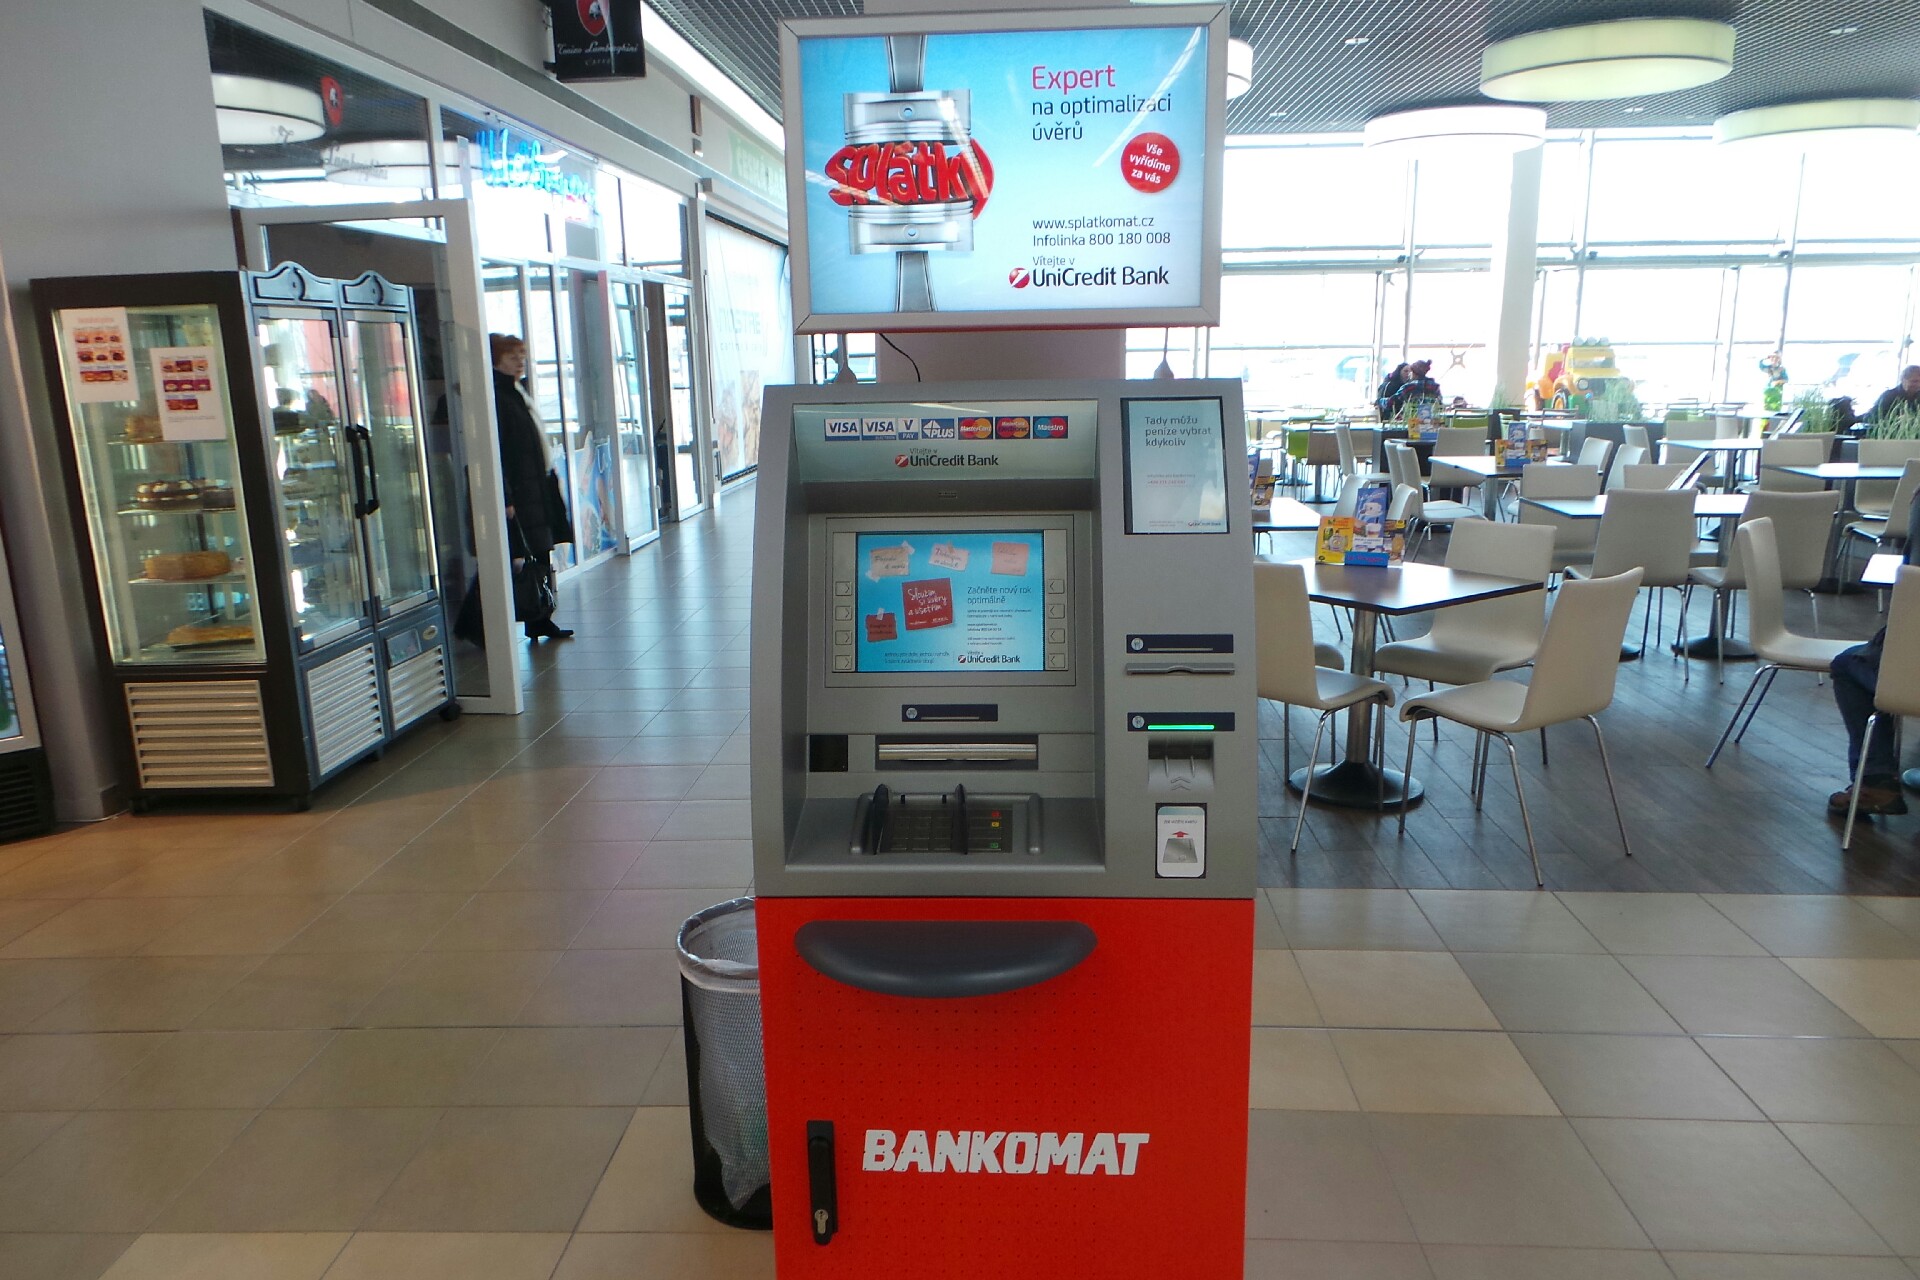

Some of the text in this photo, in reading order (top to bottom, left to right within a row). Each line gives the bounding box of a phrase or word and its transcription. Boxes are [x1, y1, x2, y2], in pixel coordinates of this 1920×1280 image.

[1032, 64, 1116, 95] Expert
[1032, 93, 1171, 119] na optimalizaci
[1032, 120, 1083, 141] úvěrů
[1146, 142, 1163, 156] Vše
[1129, 154, 1171, 173] vyřídíme
[1131, 168, 1161, 184] za vás
[1033, 215, 1154, 231] www.splatkomat.cz
[1033, 232, 1171, 247] Infolinka 800 180 008
[1033, 255, 1075, 268] Vítejte v
[1033, 265, 1170, 287] UniCredit Bank
[828, 422, 858, 433] VISA
[866, 421, 895, 432] VISA
[904, 419, 914, 430] V
[1145, 416, 1198, 426] Tady můžu
[930, 428, 954, 438] PLUS
[1145, 426, 1212, 437] peníze vybrat
[1145, 438, 1186, 448] kdykoliv
[910, 454, 999, 467] UniCredit Bank
[967, 585, 1032, 596] Začněte nový rok
[967, 595, 1006, 605] optimálně
[967, 654, 1020, 663] UniCredit Bank
[862, 1129, 1150, 1176] BANKOMAT
